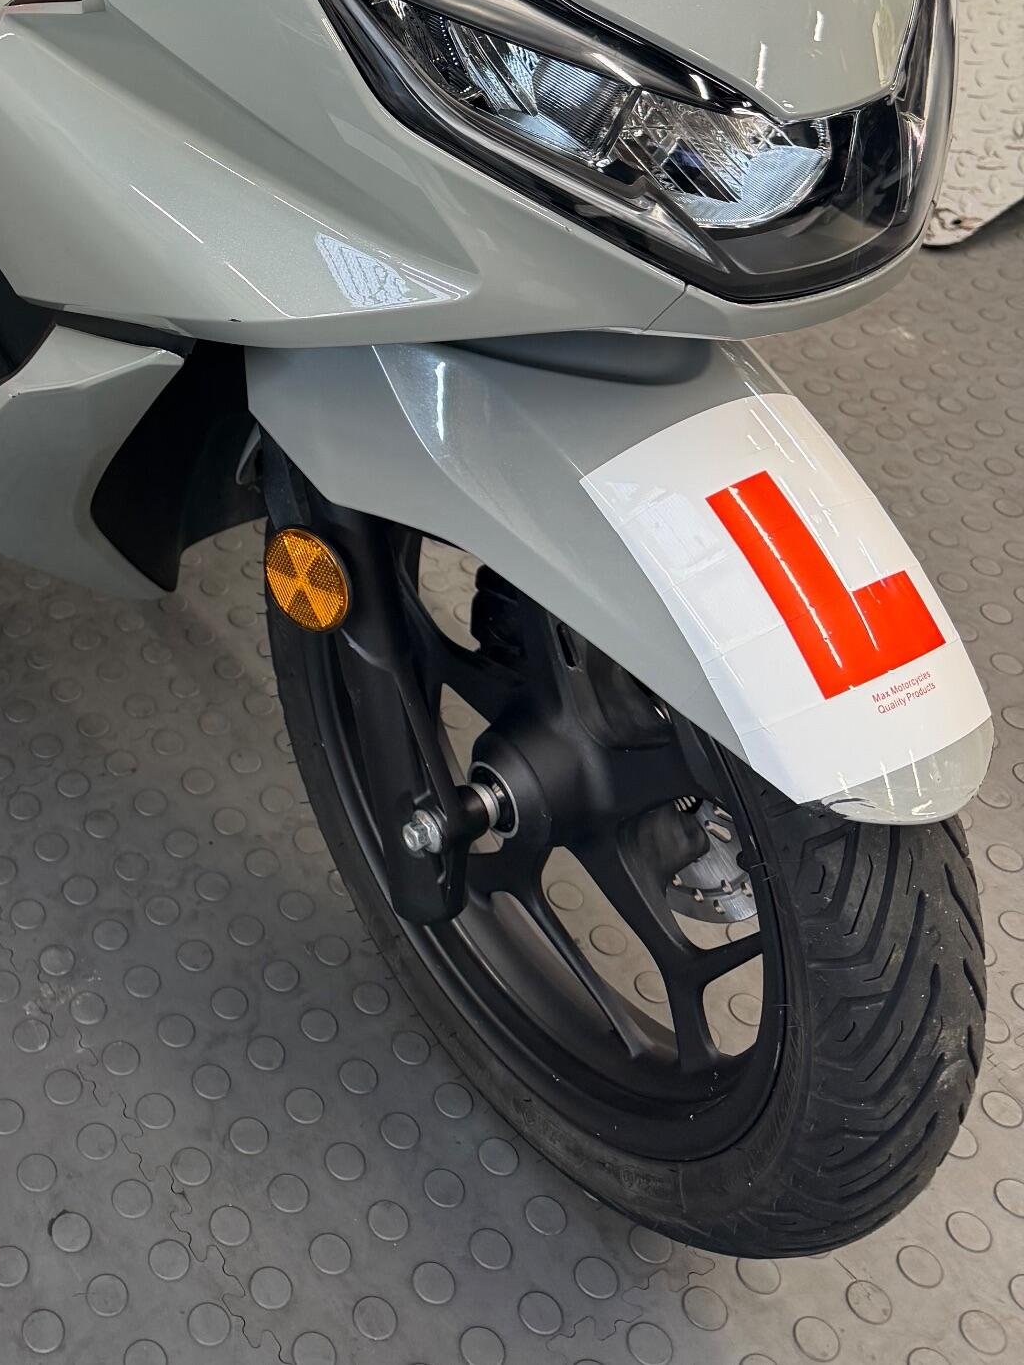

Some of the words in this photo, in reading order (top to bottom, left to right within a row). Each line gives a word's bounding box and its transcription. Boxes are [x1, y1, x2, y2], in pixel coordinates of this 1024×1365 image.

[705, 470, 946, 700] L
[871, 690, 891, 703] Max
[889, 670, 931, 695] Motorcycles
[877, 698, 907, 714] Quality
[906, 681, 936, 702] Products
